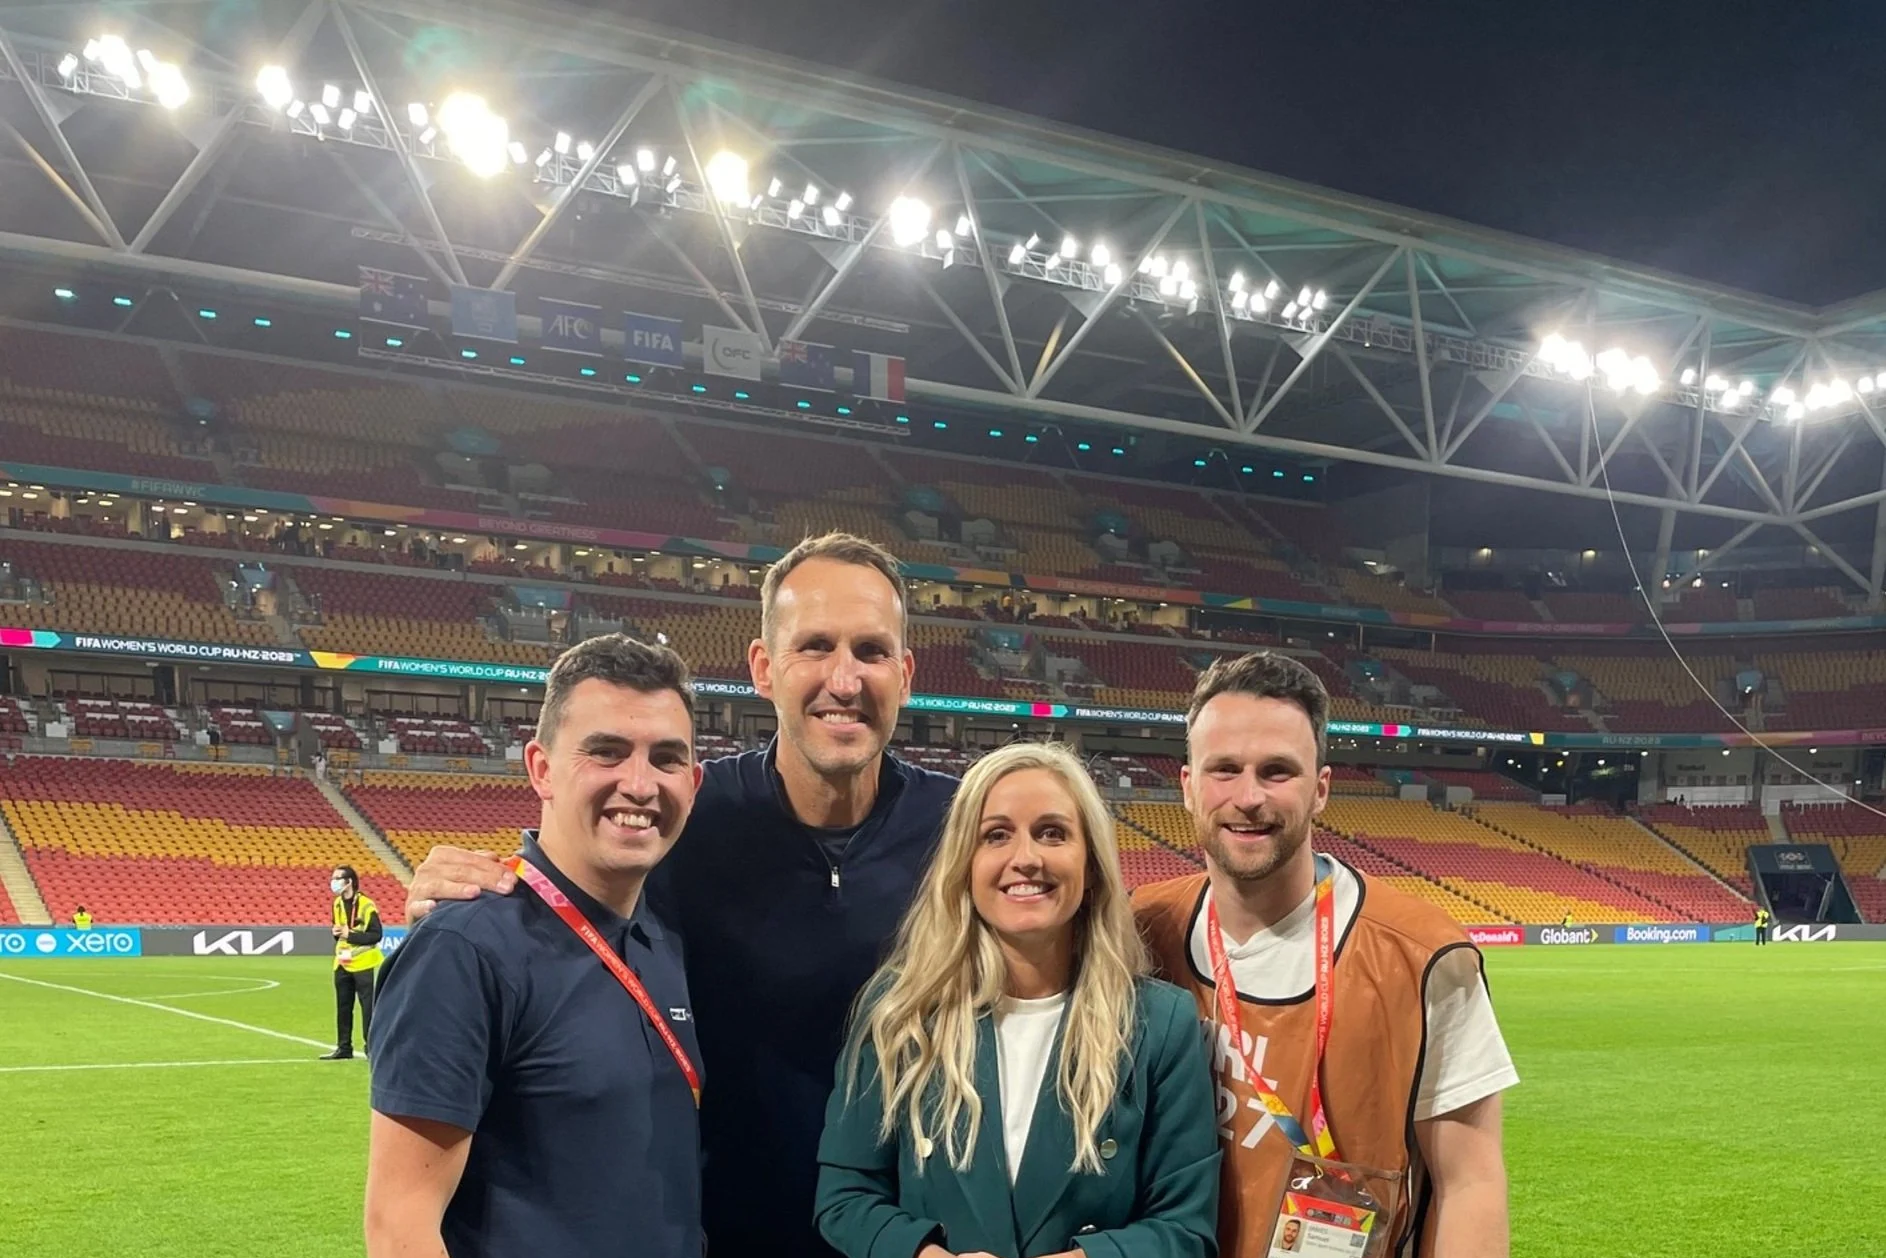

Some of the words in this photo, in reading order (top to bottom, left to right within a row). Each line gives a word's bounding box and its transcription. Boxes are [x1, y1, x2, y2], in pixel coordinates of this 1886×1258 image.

[548, 315, 593, 340] AFC
[632, 329, 673, 352] FIFA
[131, 479, 207, 498] #FIFAWWC
[478, 518, 528, 533] BEYOND
[75, 636, 101, 649] FIFA
[101, 639, 156, 652] WOMEN'S
[157, 643, 198, 656] WORLD
[199, 647, 222, 657] CUP
[378, 659, 400, 670] FIFA
[400, 661, 448, 674] WOMEN'S
[448, 665, 484, 676] WORLD
[484, 668, 504, 677] CUP
[705, 683, 736, 693] WORLD
[737, 685, 754, 694] CUP
[925, 699, 952, 708] WORLD
[954, 701, 968, 709] CUP
[1075, 708, 1090, 716] FIFA
[1124, 712, 1148, 720] WORLD
[66, 932, 133, 953] xero
[580, 924, 599, 943] FIFA
[1540, 928, 1591, 945] Globant
[1626, 926, 1698, 945] Booking.com
[1320, 972, 1330, 993] CUP
[1319, 992, 1330, 1029] WORLD
